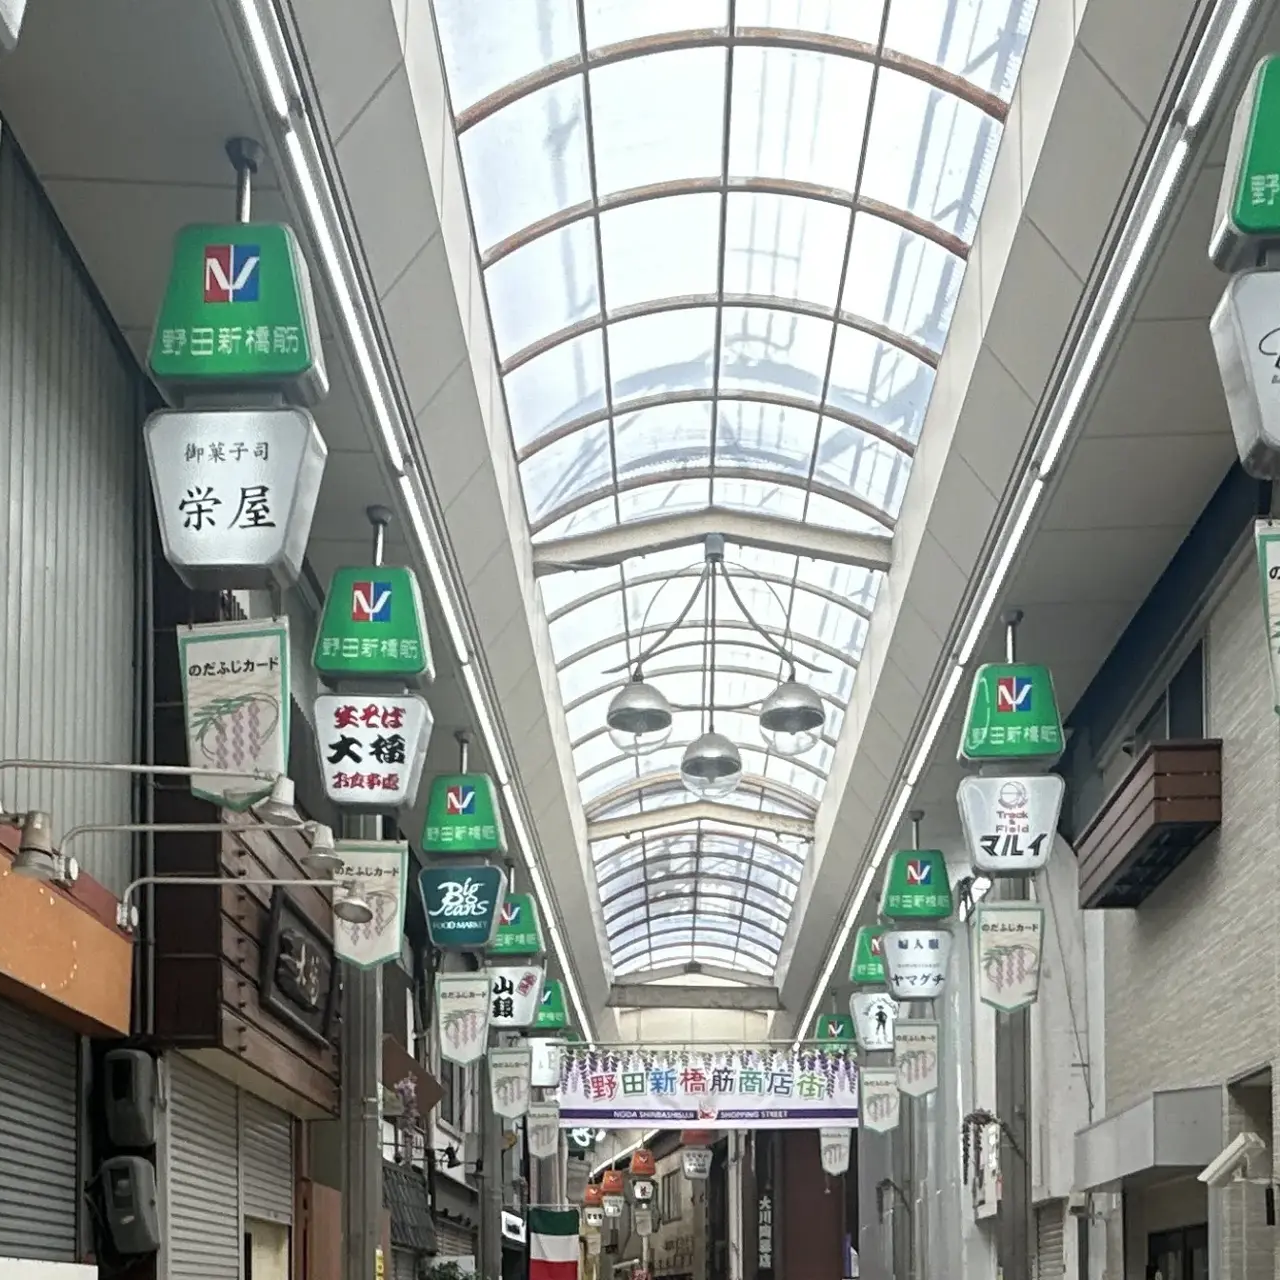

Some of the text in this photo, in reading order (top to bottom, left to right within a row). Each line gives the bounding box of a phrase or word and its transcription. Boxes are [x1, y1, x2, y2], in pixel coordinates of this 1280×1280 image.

[161, 326, 300, 356] 野田新橋筋
[184, 441, 270, 463] 御菓子司
[178, 485, 277, 531] 栄屋
[322, 638, 419, 659] 野田新橋筋
[188, 657, 280, 677] のだふじカード
[979, 833, 1047, 857] マルイ
[334, 865, 400, 878] のだふじカード
[437, 876, 486, 905] Big
[891, 972, 945, 987] ヤマグチ
[589, 1067, 826, 1100] 野田新橋筋商店街
